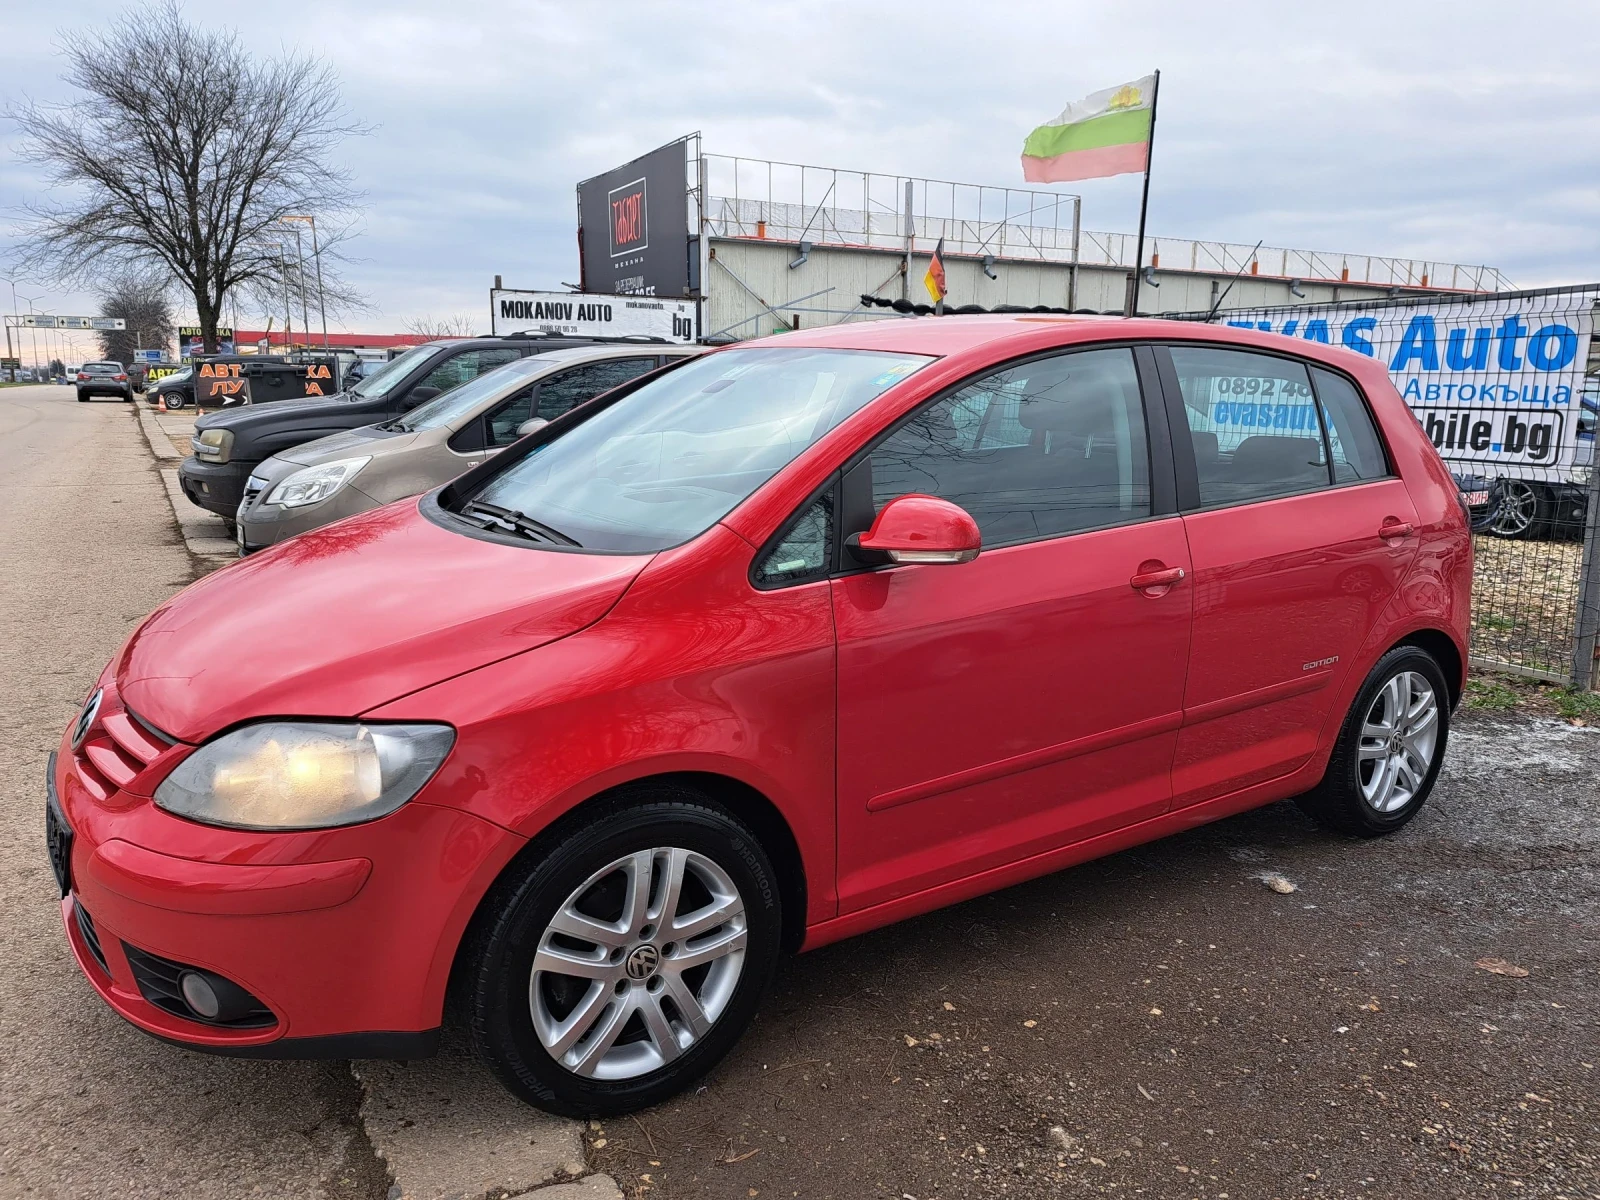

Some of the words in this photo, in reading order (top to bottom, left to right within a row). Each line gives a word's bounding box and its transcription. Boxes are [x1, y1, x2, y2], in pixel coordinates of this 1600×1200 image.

[614, 257, 644, 269] МЕХАНА
[501, 300, 573, 321] MOKANOV
[577, 304, 613, 322] AUTO
[181, 328, 231, 336] АВТОКА
[673, 313, 691, 341] bg
[1390, 314, 1578, 372] Auto
[1218, 377, 1275, 396] 0892
[1403, 378, 1571, 408] Автокъща
[1419, 413, 1552, 460] bile.bg
